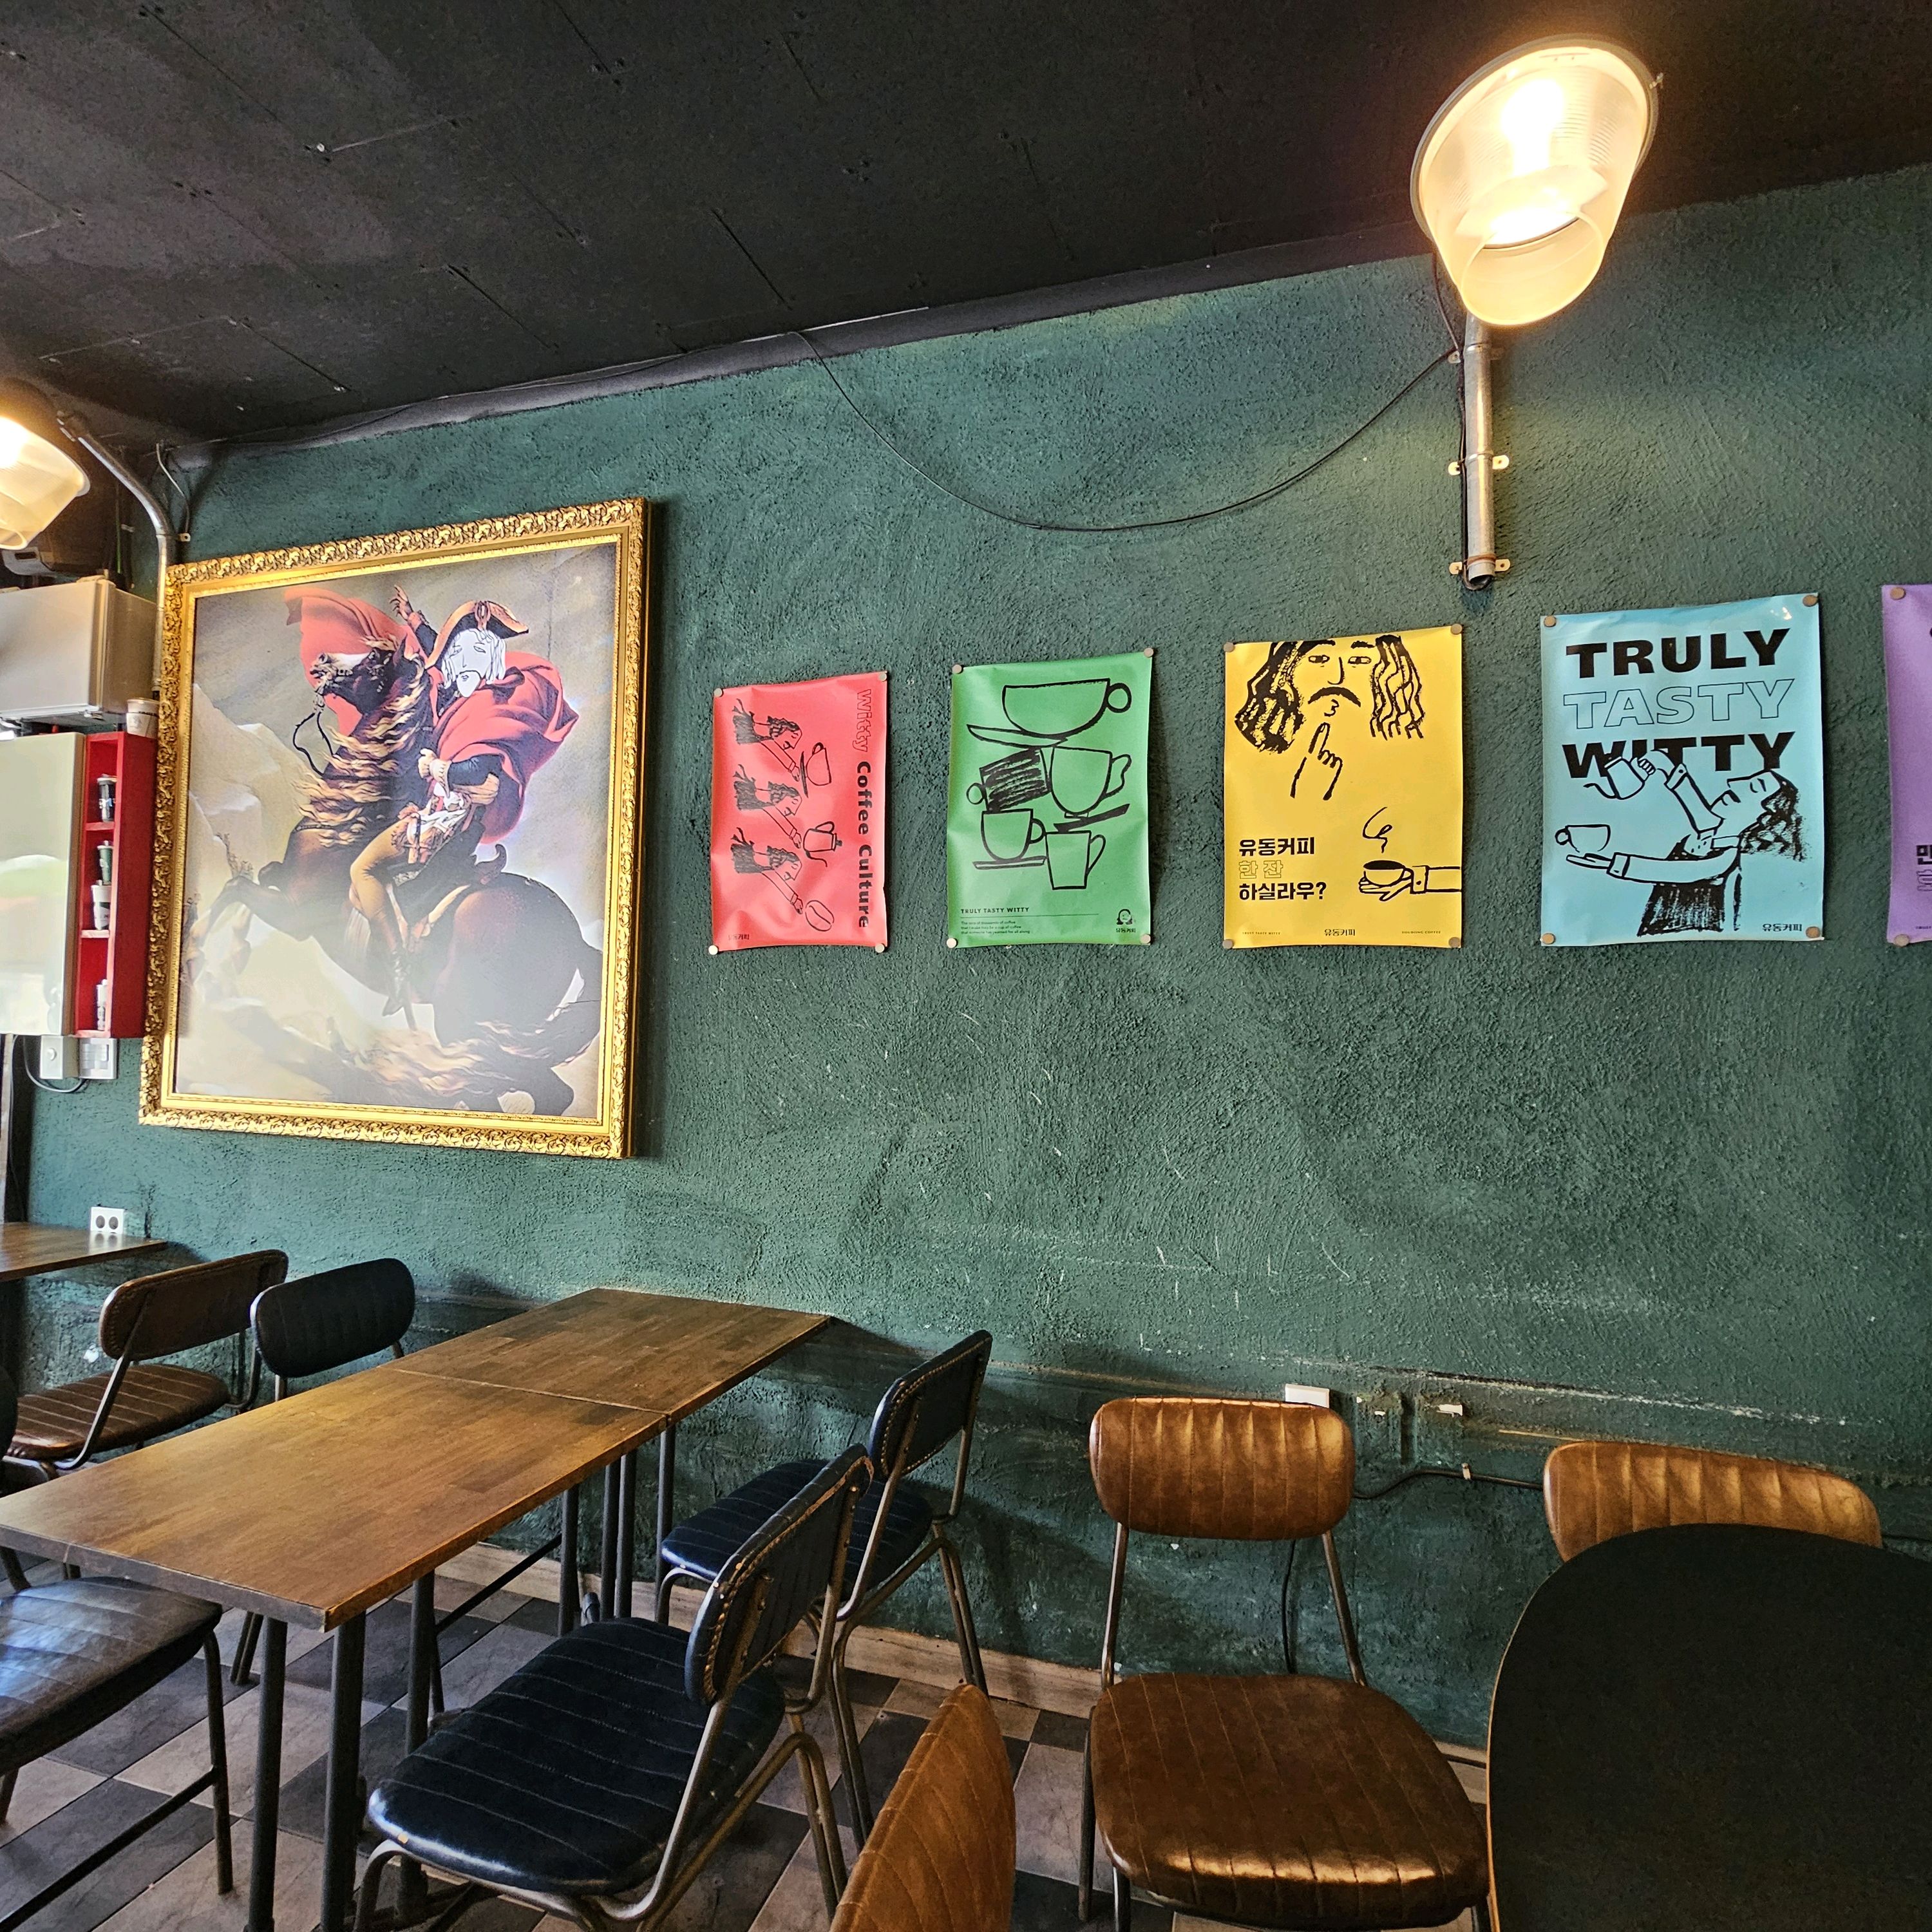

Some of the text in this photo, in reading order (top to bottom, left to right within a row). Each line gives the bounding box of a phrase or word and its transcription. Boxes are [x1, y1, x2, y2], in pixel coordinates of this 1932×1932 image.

[1566, 628, 1790, 679] TRULY
[1563, 678, 1795, 730] TASTY
[852, 688, 873, 927] Witty Coffee Culture
[1238, 837, 1314, 857] 유동커피
[1238, 859, 1283, 880] 한 잔
[1238, 881, 1327, 900] 하실라우?
[1762, 923, 1803, 932] 유동커피
